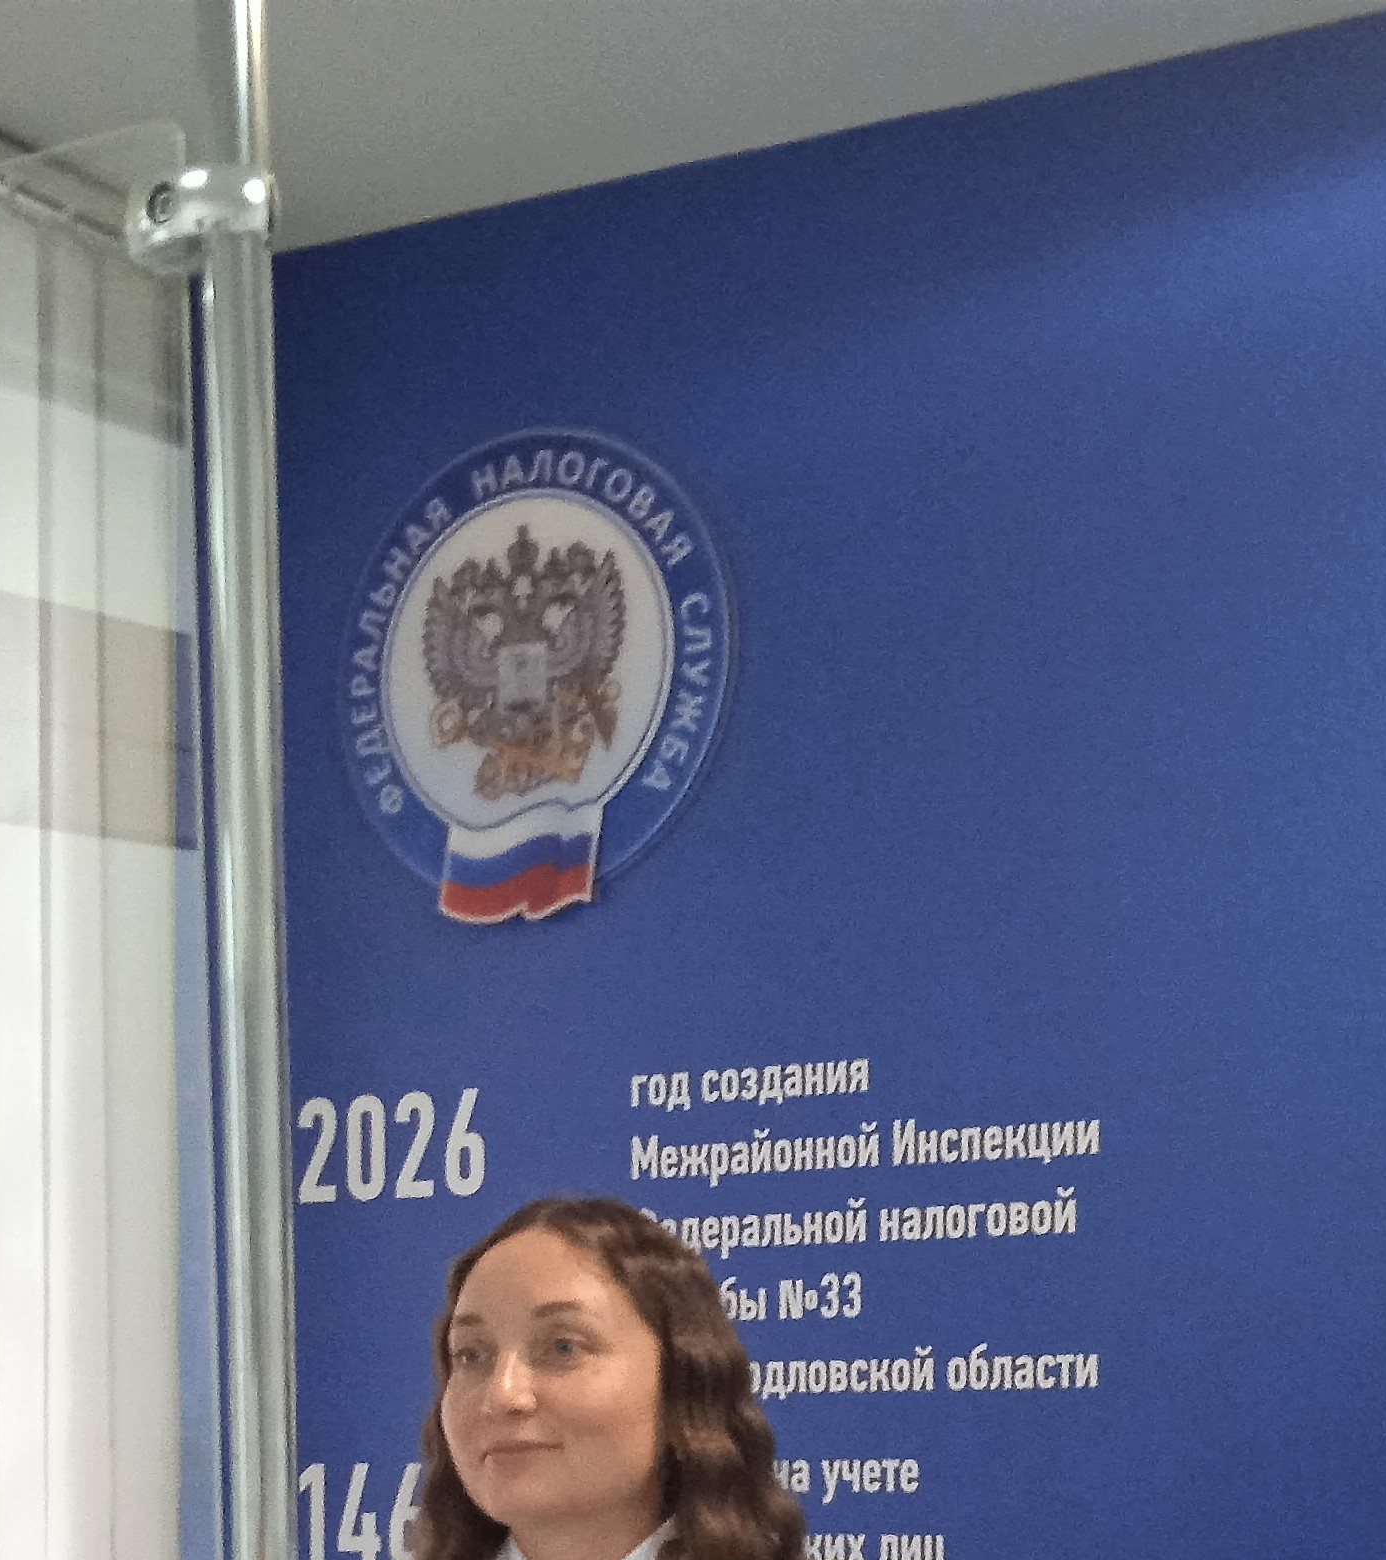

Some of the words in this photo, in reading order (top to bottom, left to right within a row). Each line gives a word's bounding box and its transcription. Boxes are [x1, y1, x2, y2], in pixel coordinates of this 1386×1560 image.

[350, 496, 453, 814] ФЕДЕРАЛЬНАЯ
[470, 449, 694, 567] НАЛОГОВАЯ
[641, 592, 713, 791] СЛУЖБА
[630, 1071, 691, 1112] год
[701, 1059, 870, 1106] создания
[298, 1087, 486, 1204] 2026
[630, 1122, 880, 1188] Межрайонной
[892, 1119, 1100, 1166] Инспекции
[879, 1187, 1077, 1241] налоговой
[778, 1272, 862, 1320] №33
[750, 1346, 934, 1400] дловской
[946, 1343, 1099, 1391] области
[820, 1458, 920, 1504] учете
